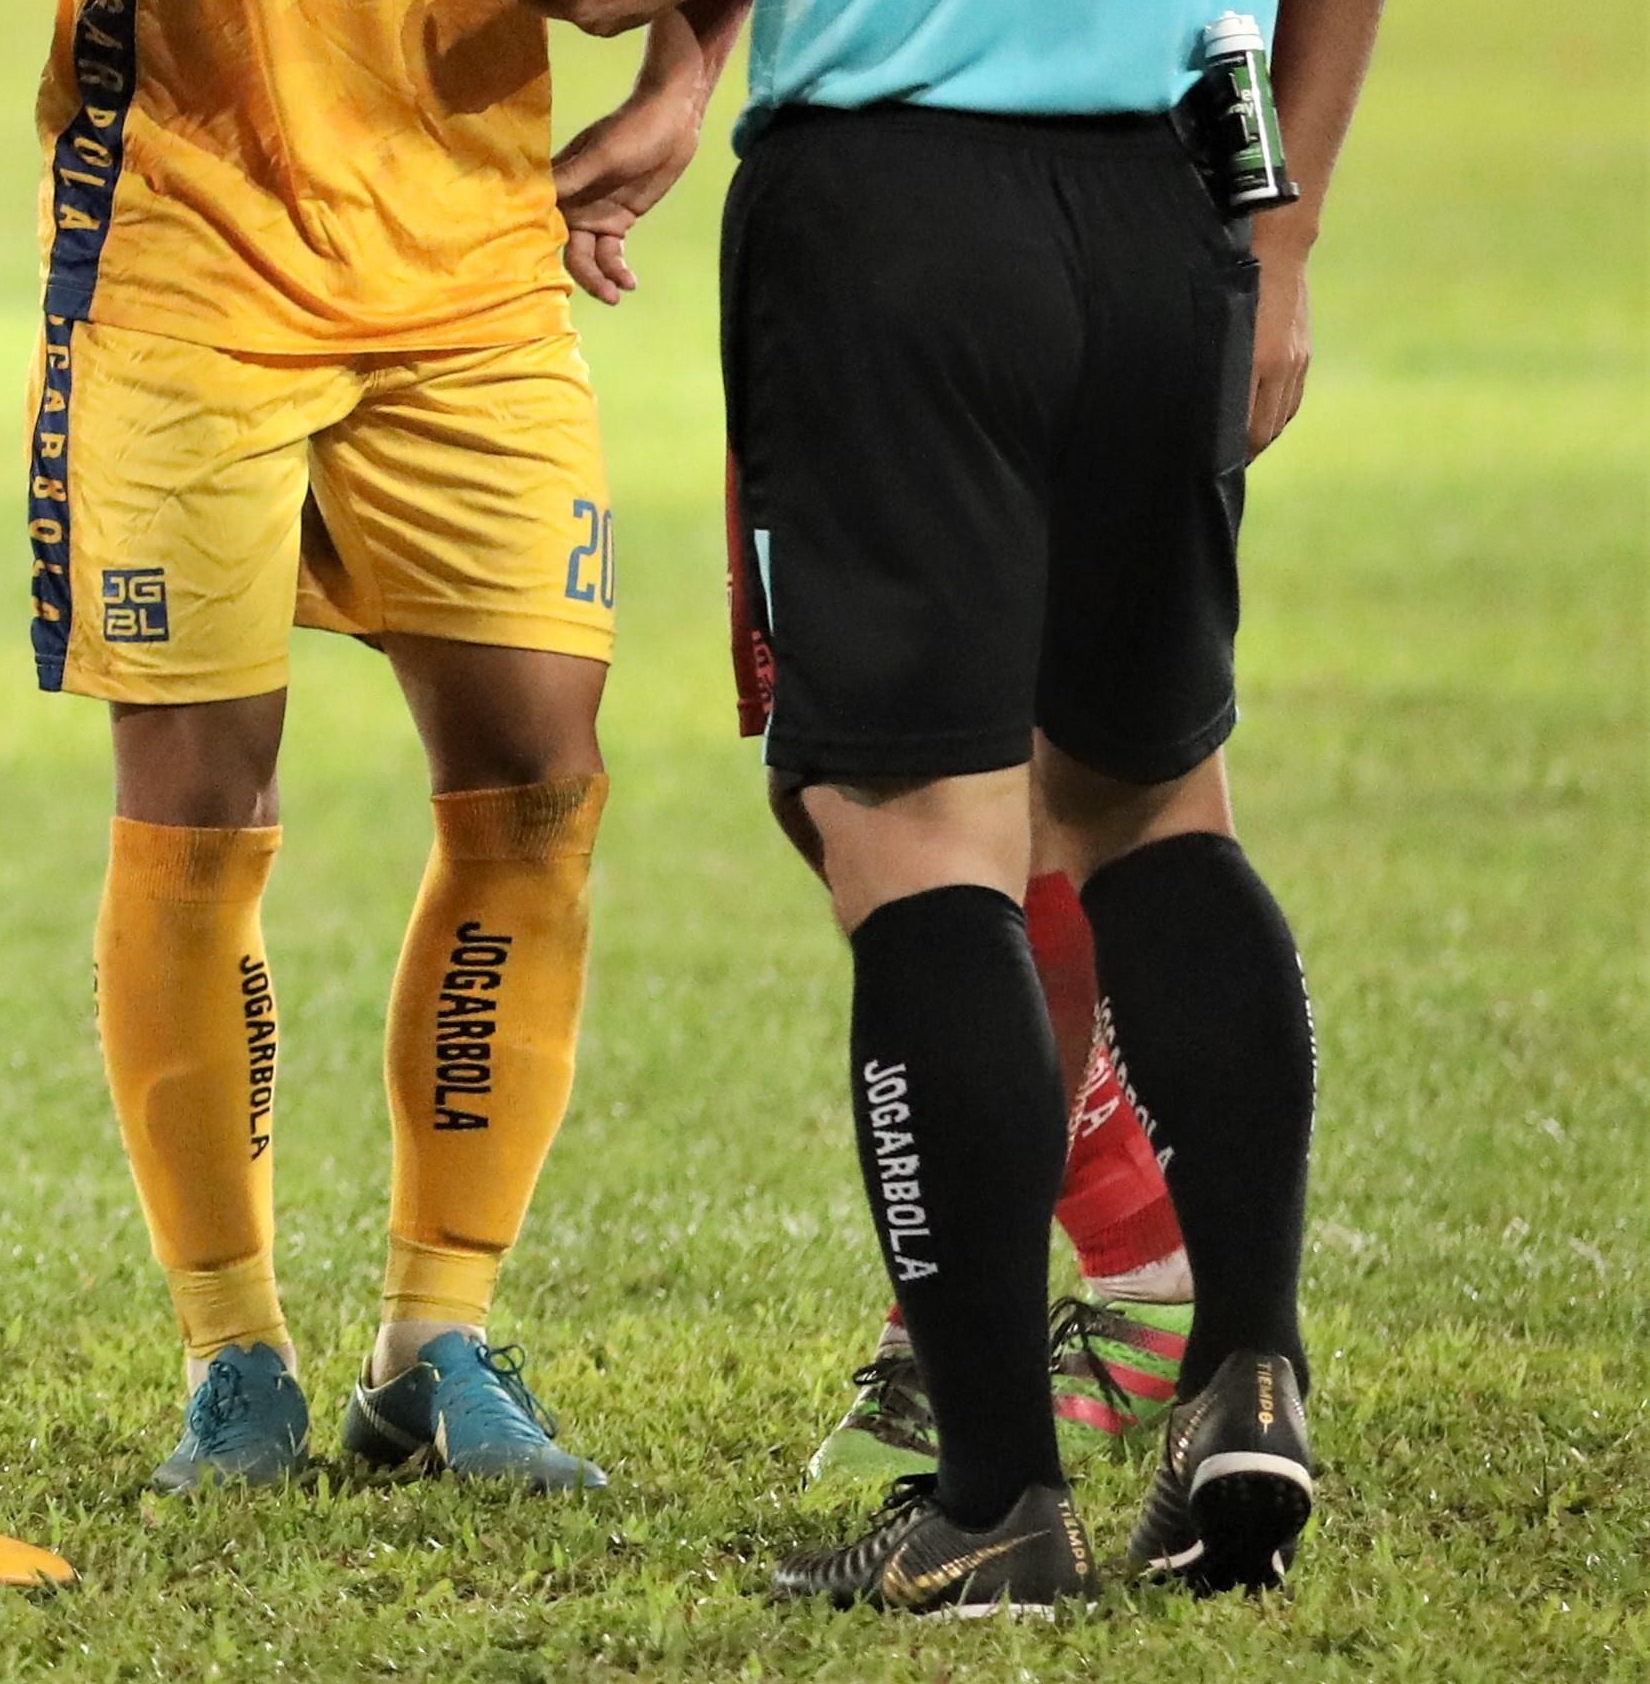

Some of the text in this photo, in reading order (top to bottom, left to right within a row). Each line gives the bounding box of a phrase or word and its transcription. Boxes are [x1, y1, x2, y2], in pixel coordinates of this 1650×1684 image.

[563, 499, 614, 610] 20
[240, 954, 275, 1162] JOGARBOLA
[435, 920, 513, 1131] JOGARBOLA
[864, 1058, 939, 1284] JOGARBOLA
